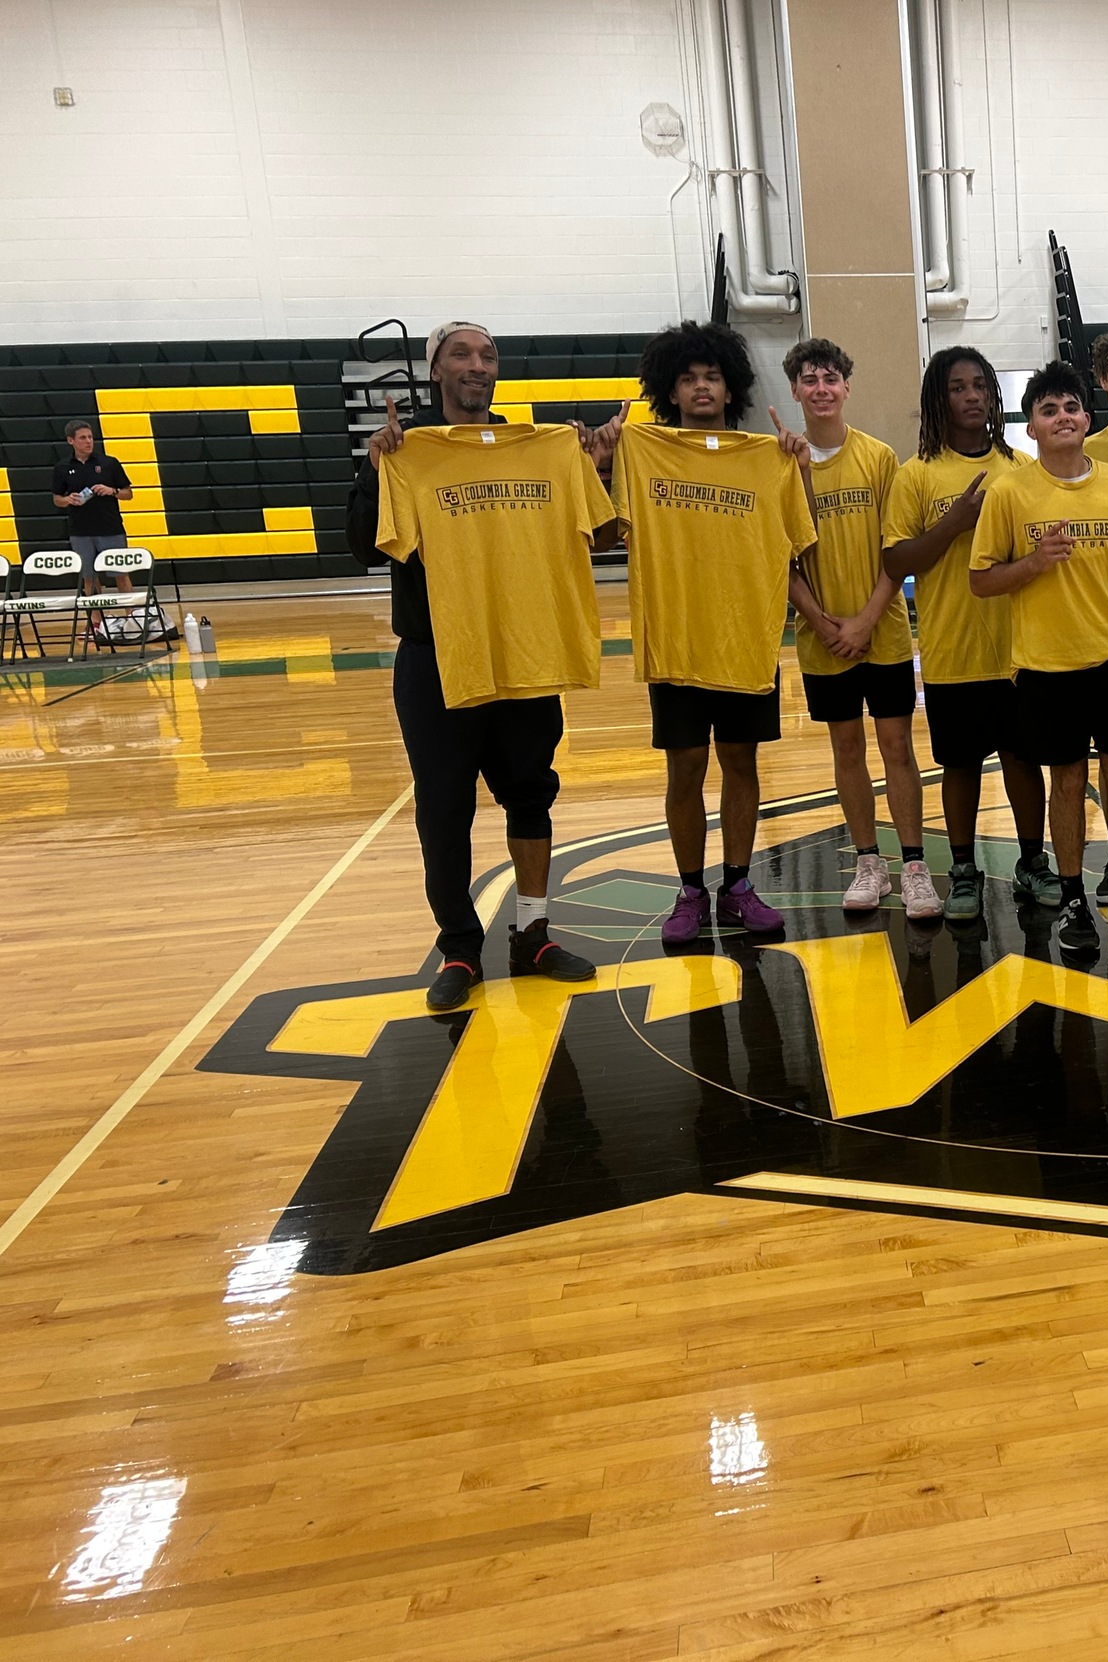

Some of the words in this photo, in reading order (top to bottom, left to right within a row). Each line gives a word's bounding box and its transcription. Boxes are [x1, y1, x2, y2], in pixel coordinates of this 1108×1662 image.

[464, 483, 511, 501] COLUMBIA
[513, 483, 547, 498] GREENE
[674, 483, 716, 502] COLUMBIA
[719, 490, 751, 508] GREENE
[816, 493, 840, 510] UMBIA
[842, 490, 870, 504] GREENE
[450, 502, 543, 517] BASKETBALL
[656, 499, 745, 518] BASKETBALL
[818, 507, 867, 520] KETBALL
[33, 556, 73, 569] CGCC
[104, 553, 143, 566] CGCC
[9, 602, 46, 610] TWINS
[82, 598, 118, 607] TWINS
